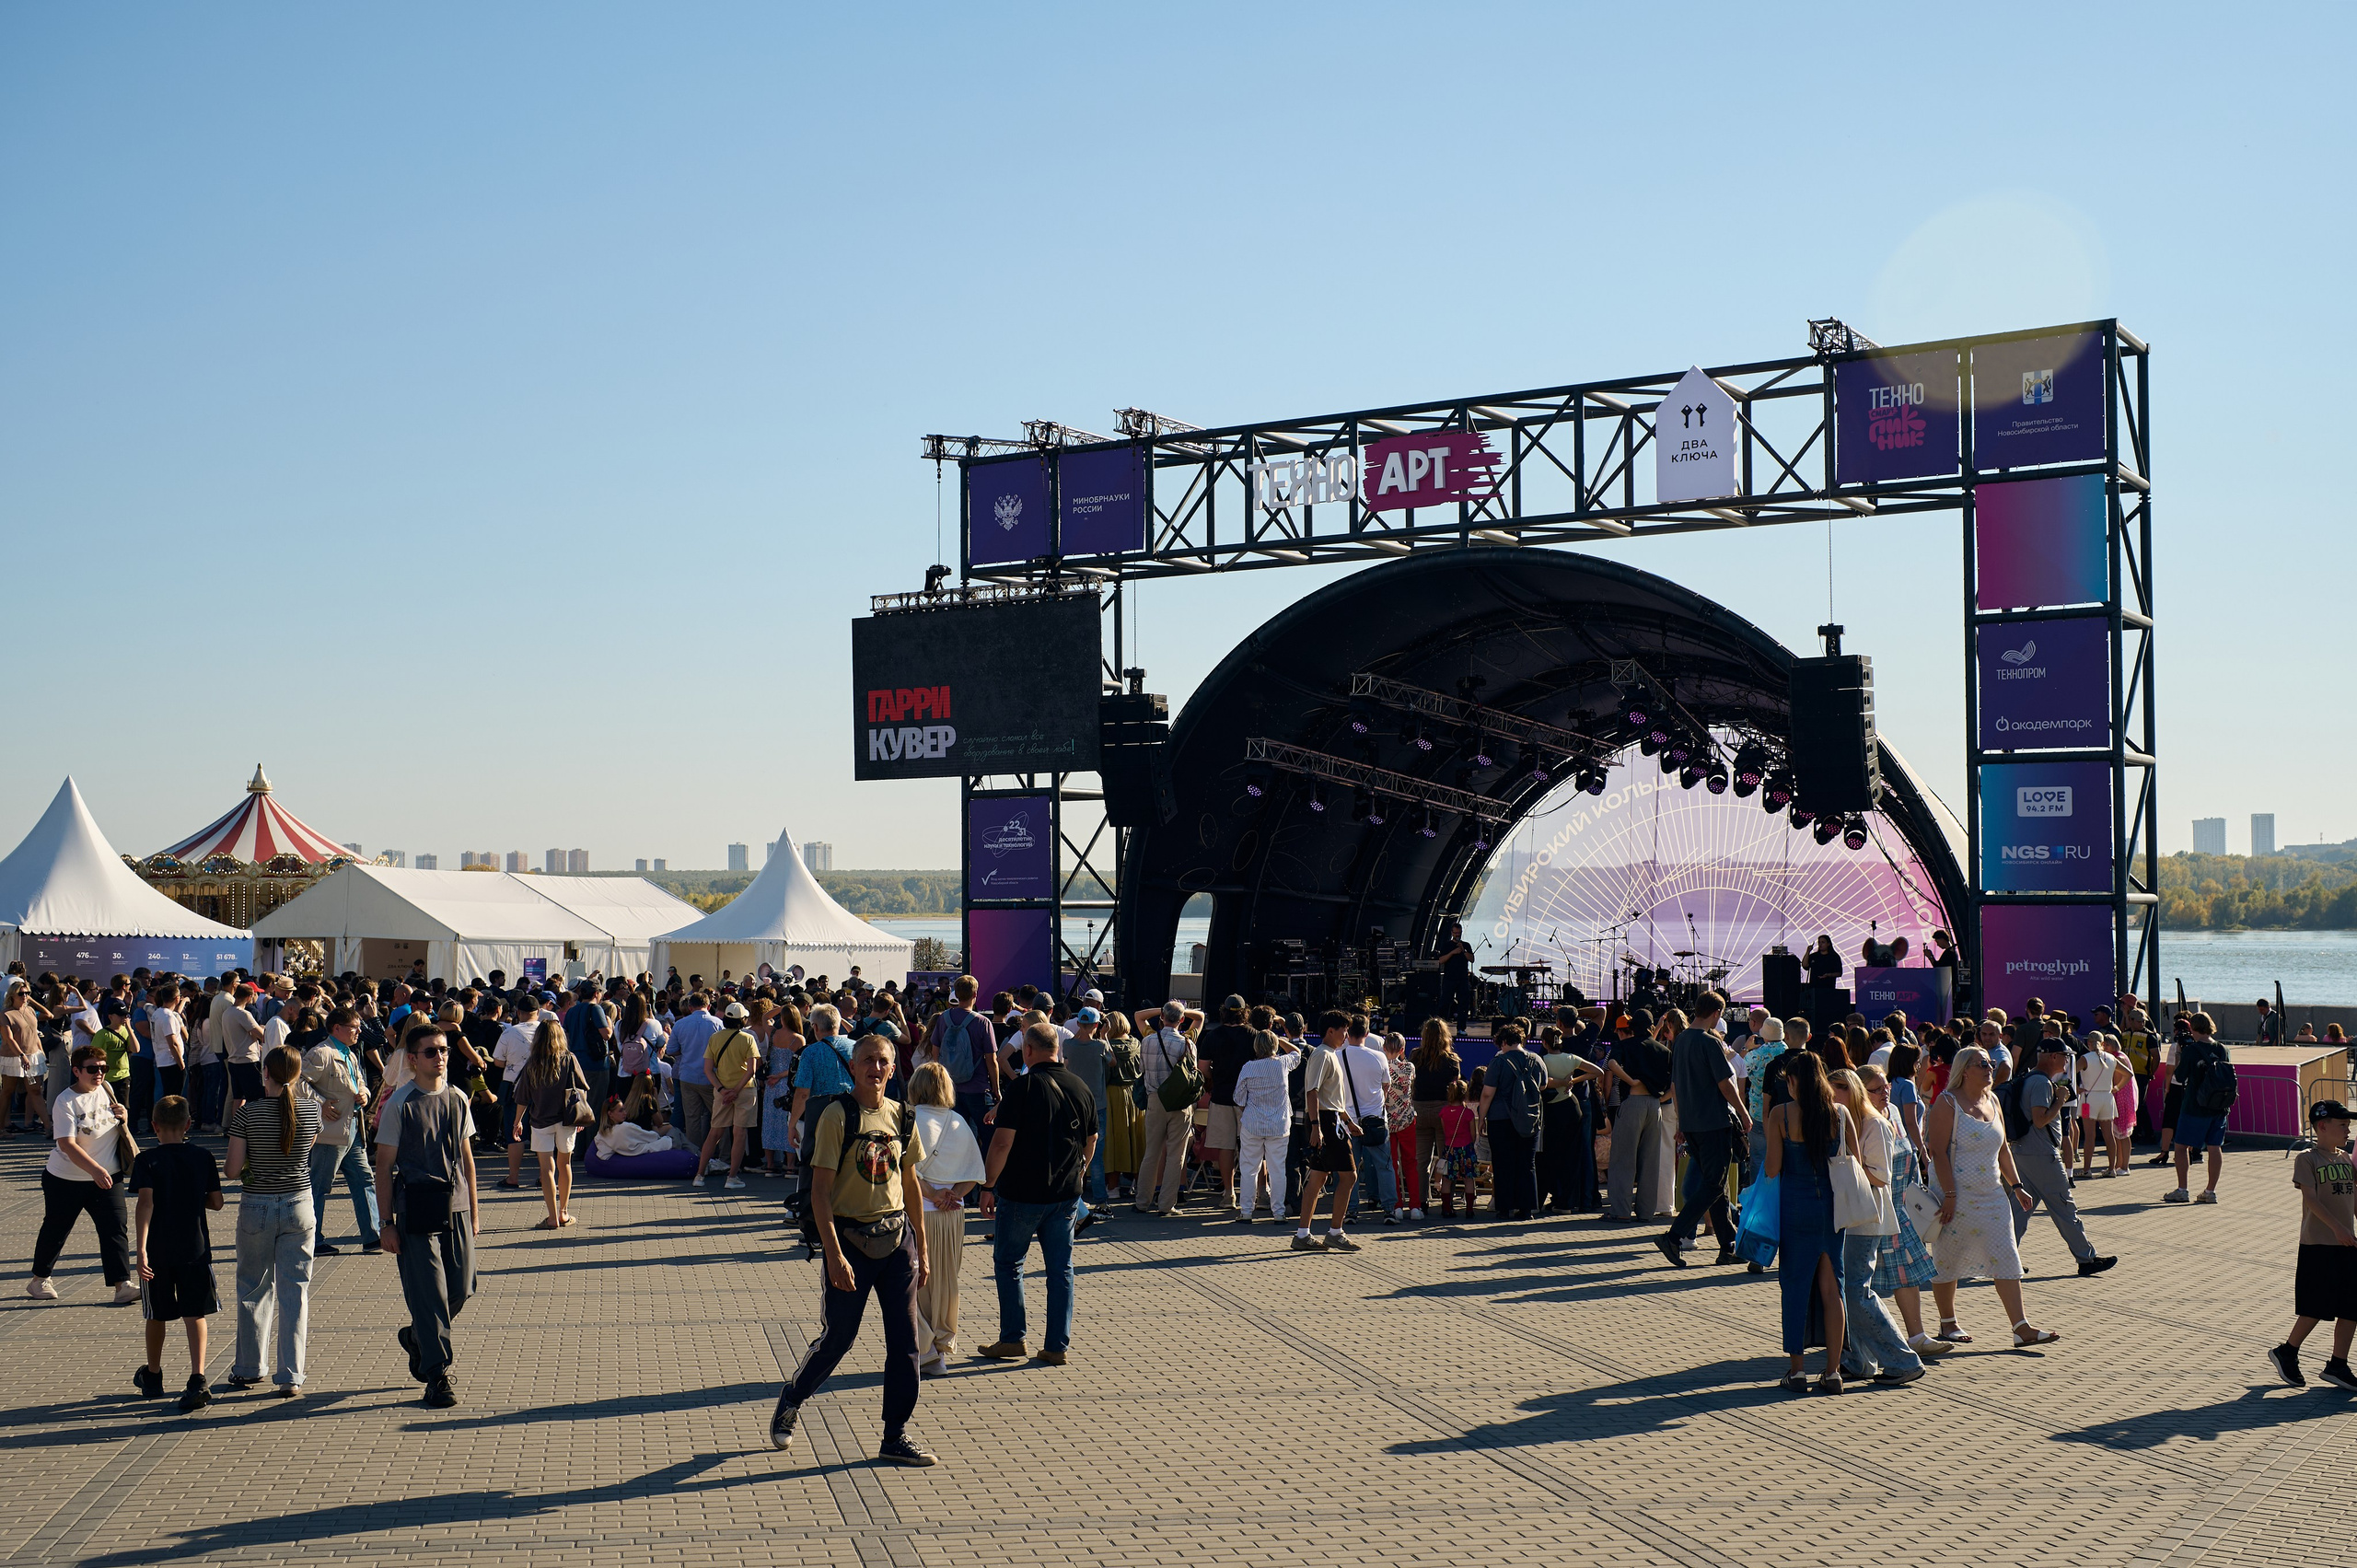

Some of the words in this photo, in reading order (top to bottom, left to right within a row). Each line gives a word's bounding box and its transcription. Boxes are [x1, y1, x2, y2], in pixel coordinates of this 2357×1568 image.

[1869, 383, 1924, 410] ТЕХНО
[2012, 417, 2063, 428] Правительство
[1998, 425, 2049, 436] Новосибирской
[2050, 424, 2079, 432] области
[1681, 439, 1708, 451] ДВА
[1671, 450, 1718, 463] КЛЮЧА
[1248, 453, 1357, 510] ТЕХНО
[1377, 447, 1452, 495] АРТ
[1073, 494, 1130, 505] МИНОБРНАУКИ
[1073, 505, 1103, 514] РОССИИ
[1996, 668, 2046, 680] ТЕХНОПРОМ
[867, 685, 951, 723] ГАРРИ
[2012, 719, 2092, 732] академпарк
[868, 725, 957, 761] КУВЕР
[1018, 743, 1025, 754] в
[1009, 819, 1020, 829] 22
[1017, 828, 1027, 836] 31
[1493, 810, 1592, 938] СИБИРСКИЙ
[1591, 773, 1682, 819] КОЛЬЦЕ
[2002, 845, 2050, 859] NGS
[2065, 845, 2091, 859] RU
[2006, 959, 2090, 976] petroglyph
[1869, 991, 1896, 1001] ТЕХНО
[1898, 992, 1914, 1000] АРТ
[2316, 1163, 2354, 1184] TOKY
[2331, 1182, 2354, 1196] 東京
